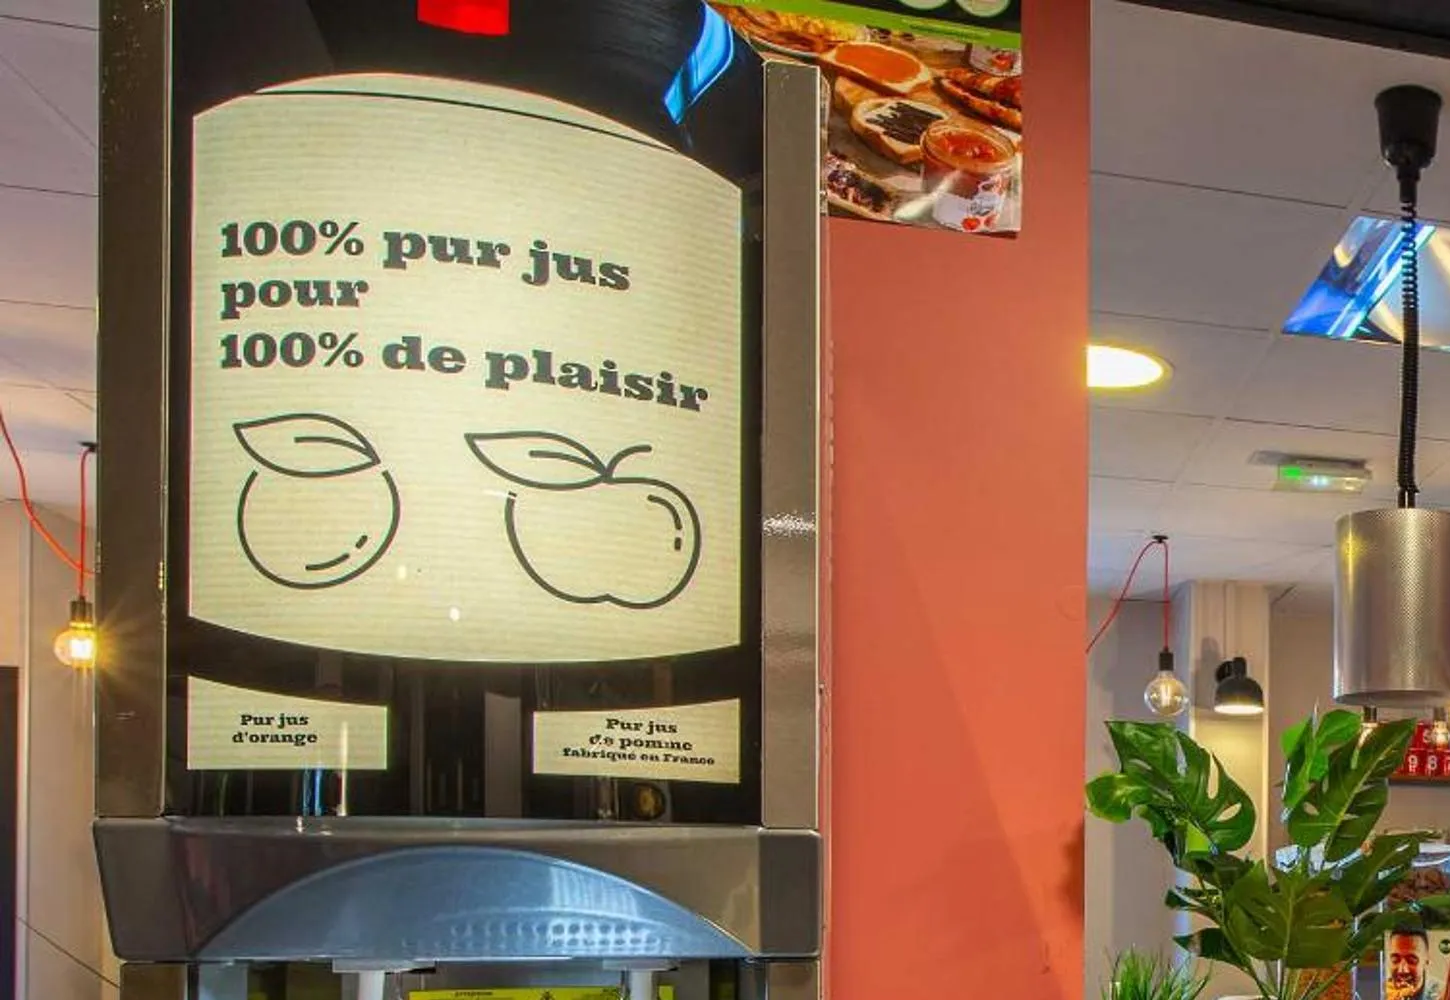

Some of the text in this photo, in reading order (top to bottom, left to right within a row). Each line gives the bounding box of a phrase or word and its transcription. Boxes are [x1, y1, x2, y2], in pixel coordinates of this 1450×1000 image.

[221, 220, 630, 291] 100% pur jus
[221, 279, 369, 320] pour
[220, 332, 709, 412] 100% de plaisir
[240, 713, 309, 729] Pur jus
[606, 718, 678, 735] Pur jus
[232, 732, 318, 746] d'orange
[589, 734, 693, 751] de pomme
[662, 753, 715, 765] France
